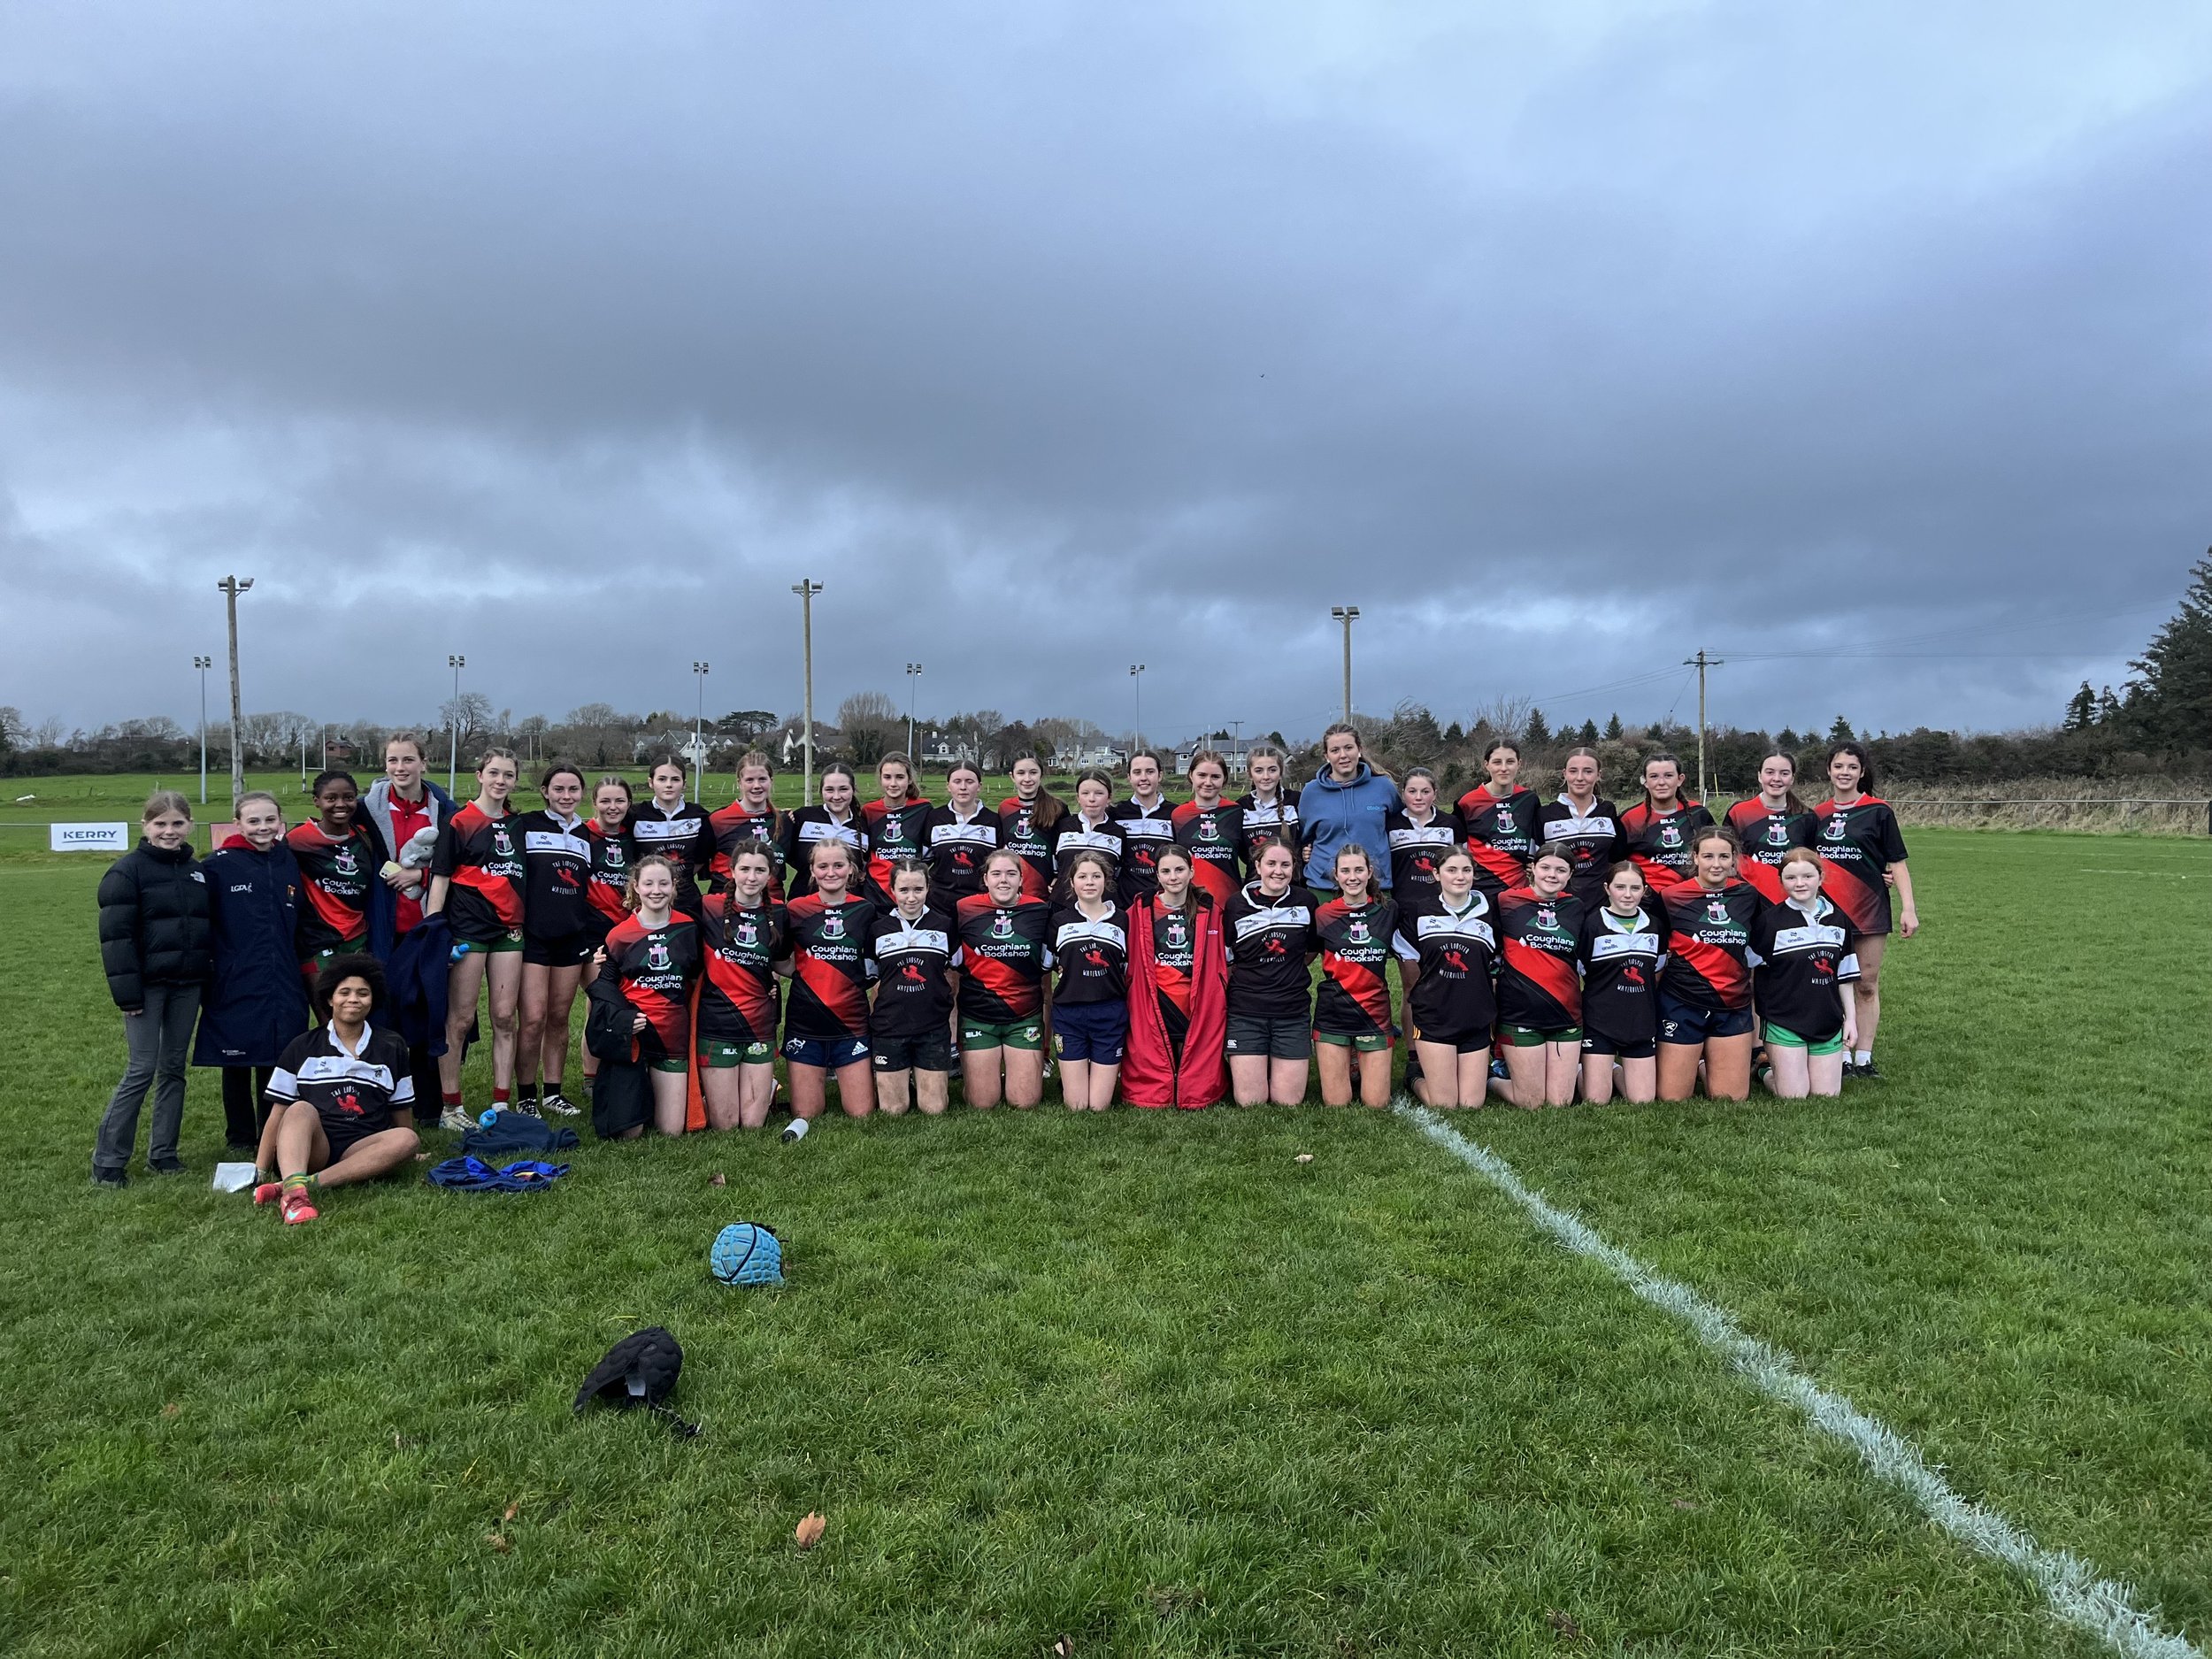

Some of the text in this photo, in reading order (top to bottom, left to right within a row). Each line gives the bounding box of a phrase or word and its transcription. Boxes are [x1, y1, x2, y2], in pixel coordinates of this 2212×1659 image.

[63, 830, 117, 839] KERRY
[1008, 841, 1047, 851] Coughlans
[1139, 843, 1156, 853] LOBSTER
[1191, 846, 1233, 856] Coughlans
[1816, 845, 1862, 856] Coughlans
[877, 847, 917, 856] Coughlans
[1819, 852, 1863, 861] Bookshop
[1699, 929, 1747, 940] Coughlans
[1525, 933, 1575, 947] Coughlans
[1703, 937, 1747, 946] Bookshop
[810, 945, 857, 956] Coughlans
[980, 942, 1031, 953] Coughlans
[1340, 947, 1386, 957] Coughlans
[1440, 942, 1470, 955] THE LOBSTER
[721, 947, 770, 963] Coughlans
[814, 952, 858, 962] Bookshop
[1816, 949, 1834, 960] LOBSTER
[905, 956, 925, 966] LOBSTER
[896, 982, 926, 993] WATERVILLE
